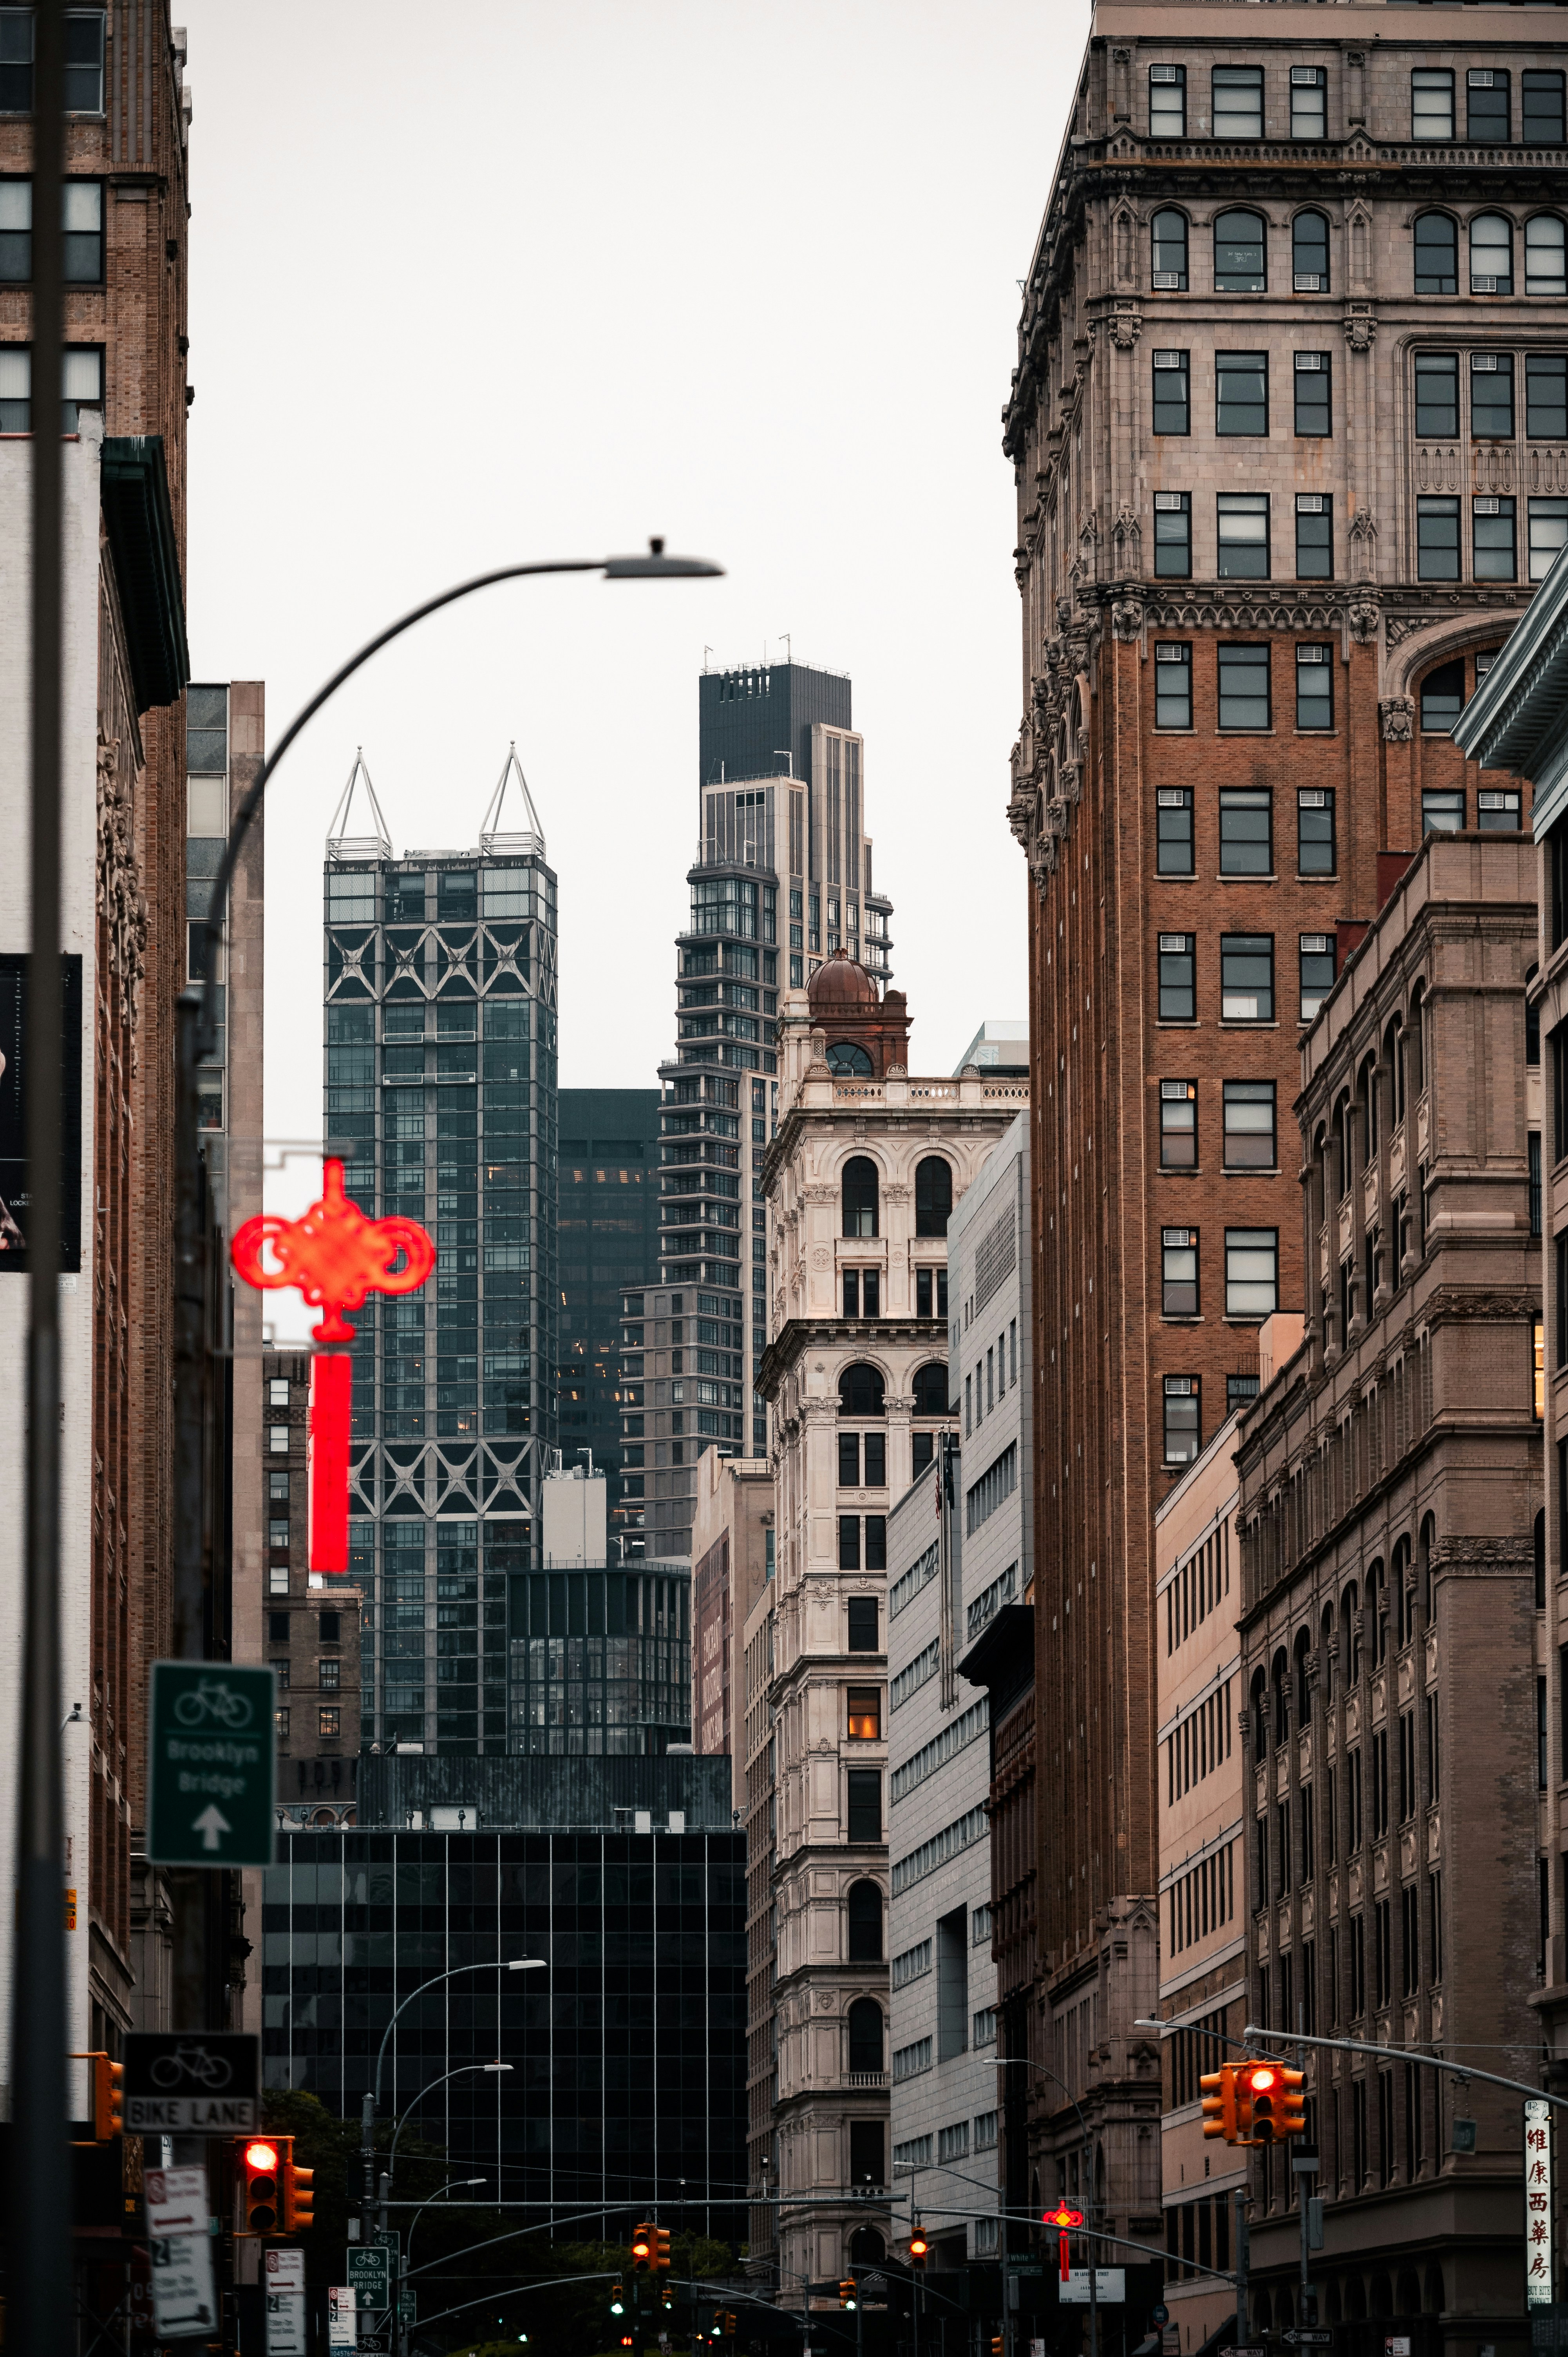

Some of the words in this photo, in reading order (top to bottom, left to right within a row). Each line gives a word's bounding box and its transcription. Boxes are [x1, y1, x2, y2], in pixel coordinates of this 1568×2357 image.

[168, 1739, 259, 1767] Brooklyn
[179, 1771, 247, 1799] Bridge
[132, 2102, 179, 2124] BIKE
[192, 2102, 250, 2125] LANE
[1527, 2128, 1549, 2279] 維康西藥房
[1528, 2286, 1537, 2295] BUY
[1539, 2286, 1550, 2295] RITE
[331, 2313, 336, 2321] 2
